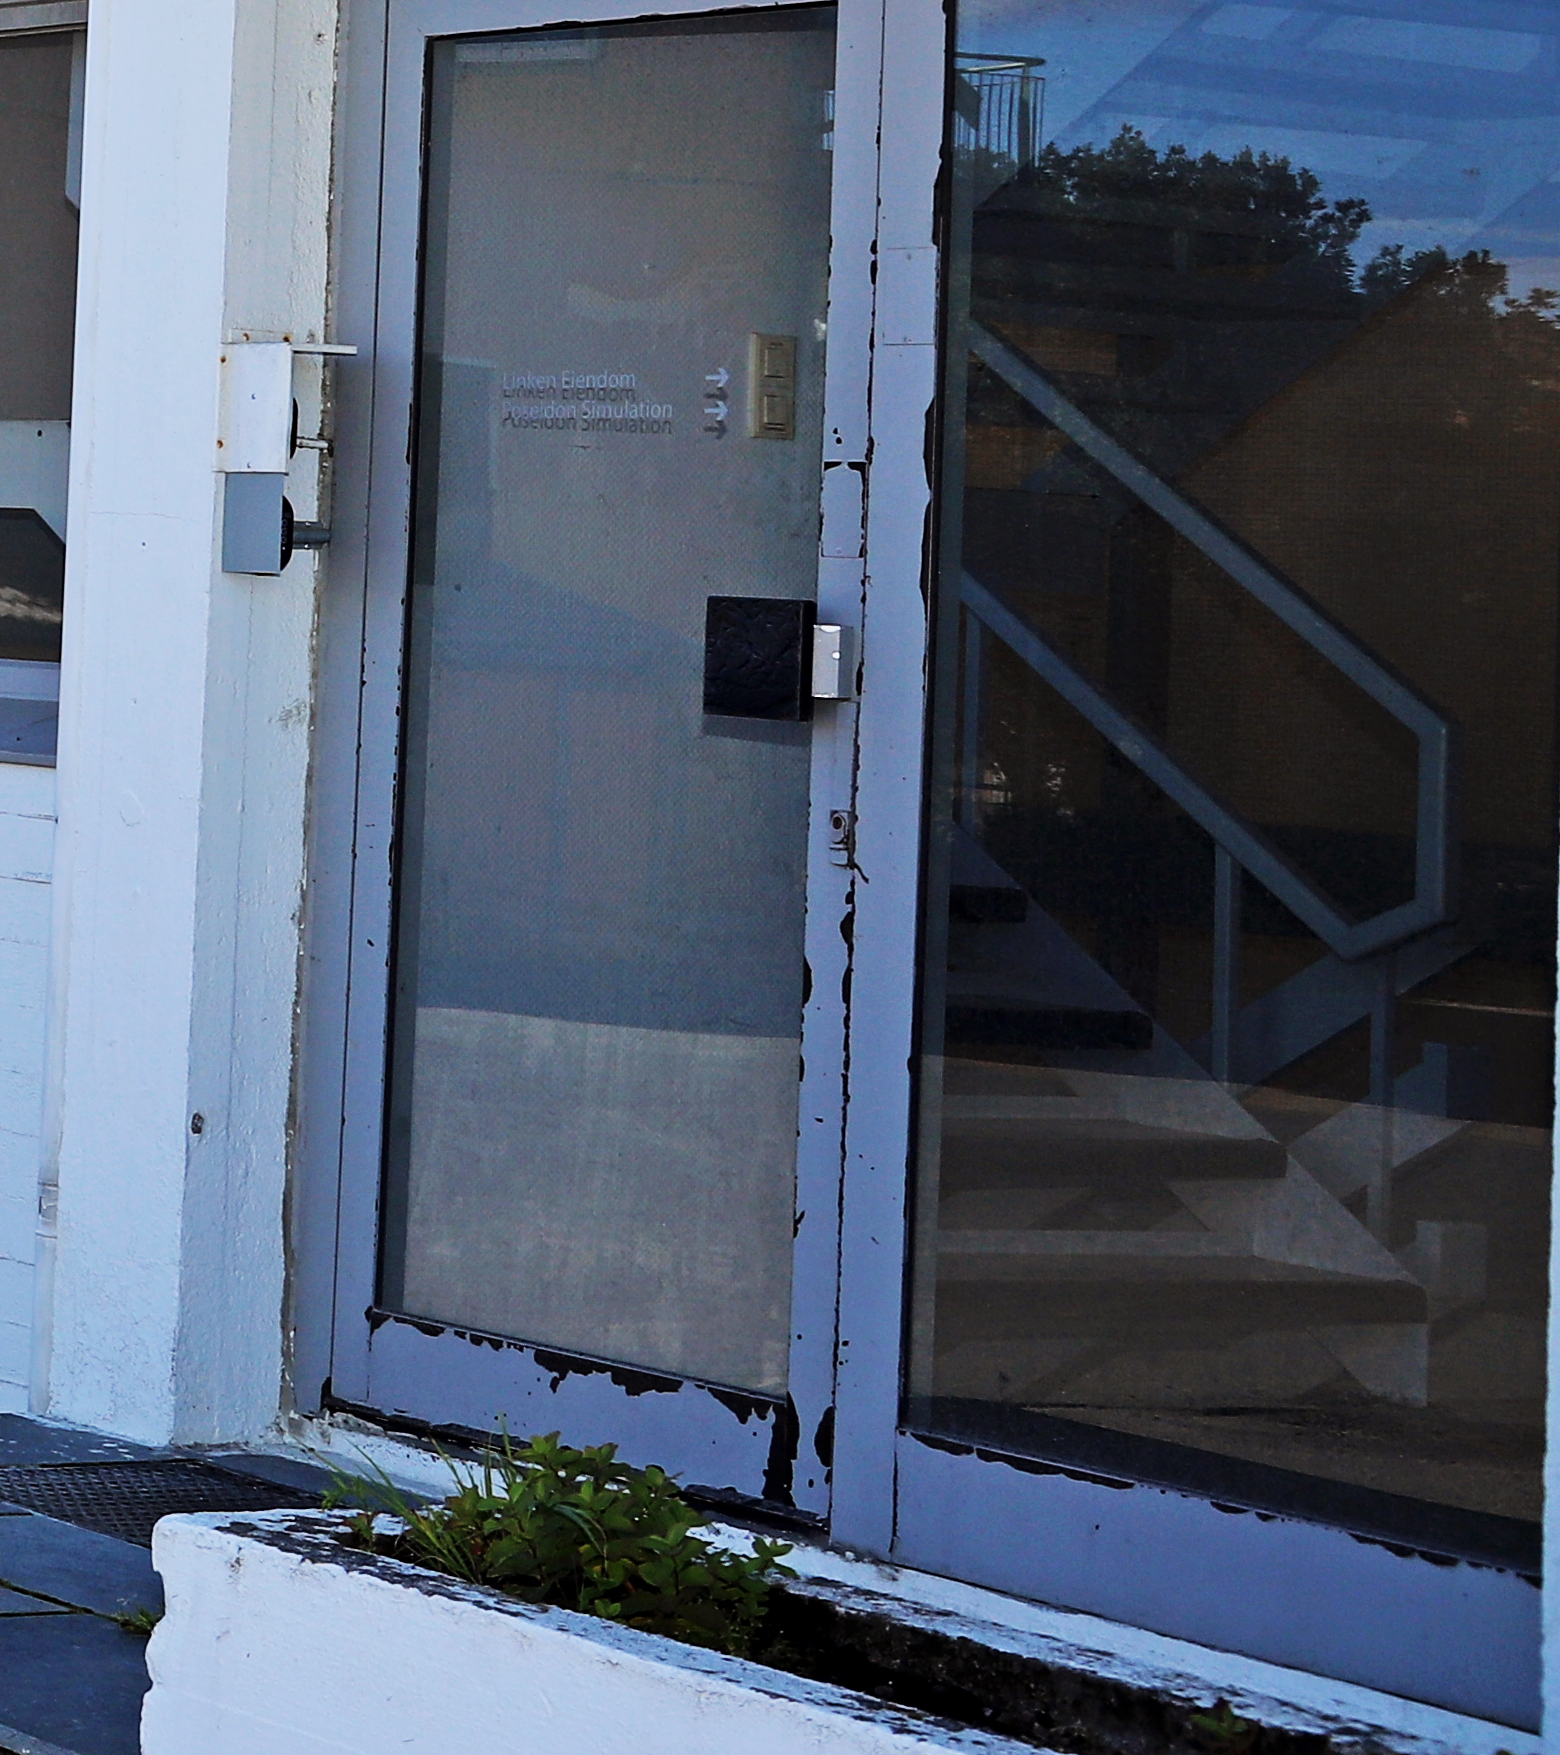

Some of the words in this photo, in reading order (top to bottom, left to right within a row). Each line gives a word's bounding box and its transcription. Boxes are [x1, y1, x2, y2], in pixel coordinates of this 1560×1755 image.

[502, 371, 556, 389] Linken
[561, 370, 635, 388] Eiendom
[502, 400, 577, 419] Poseidon
[581, 399, 673, 419] Simulation
